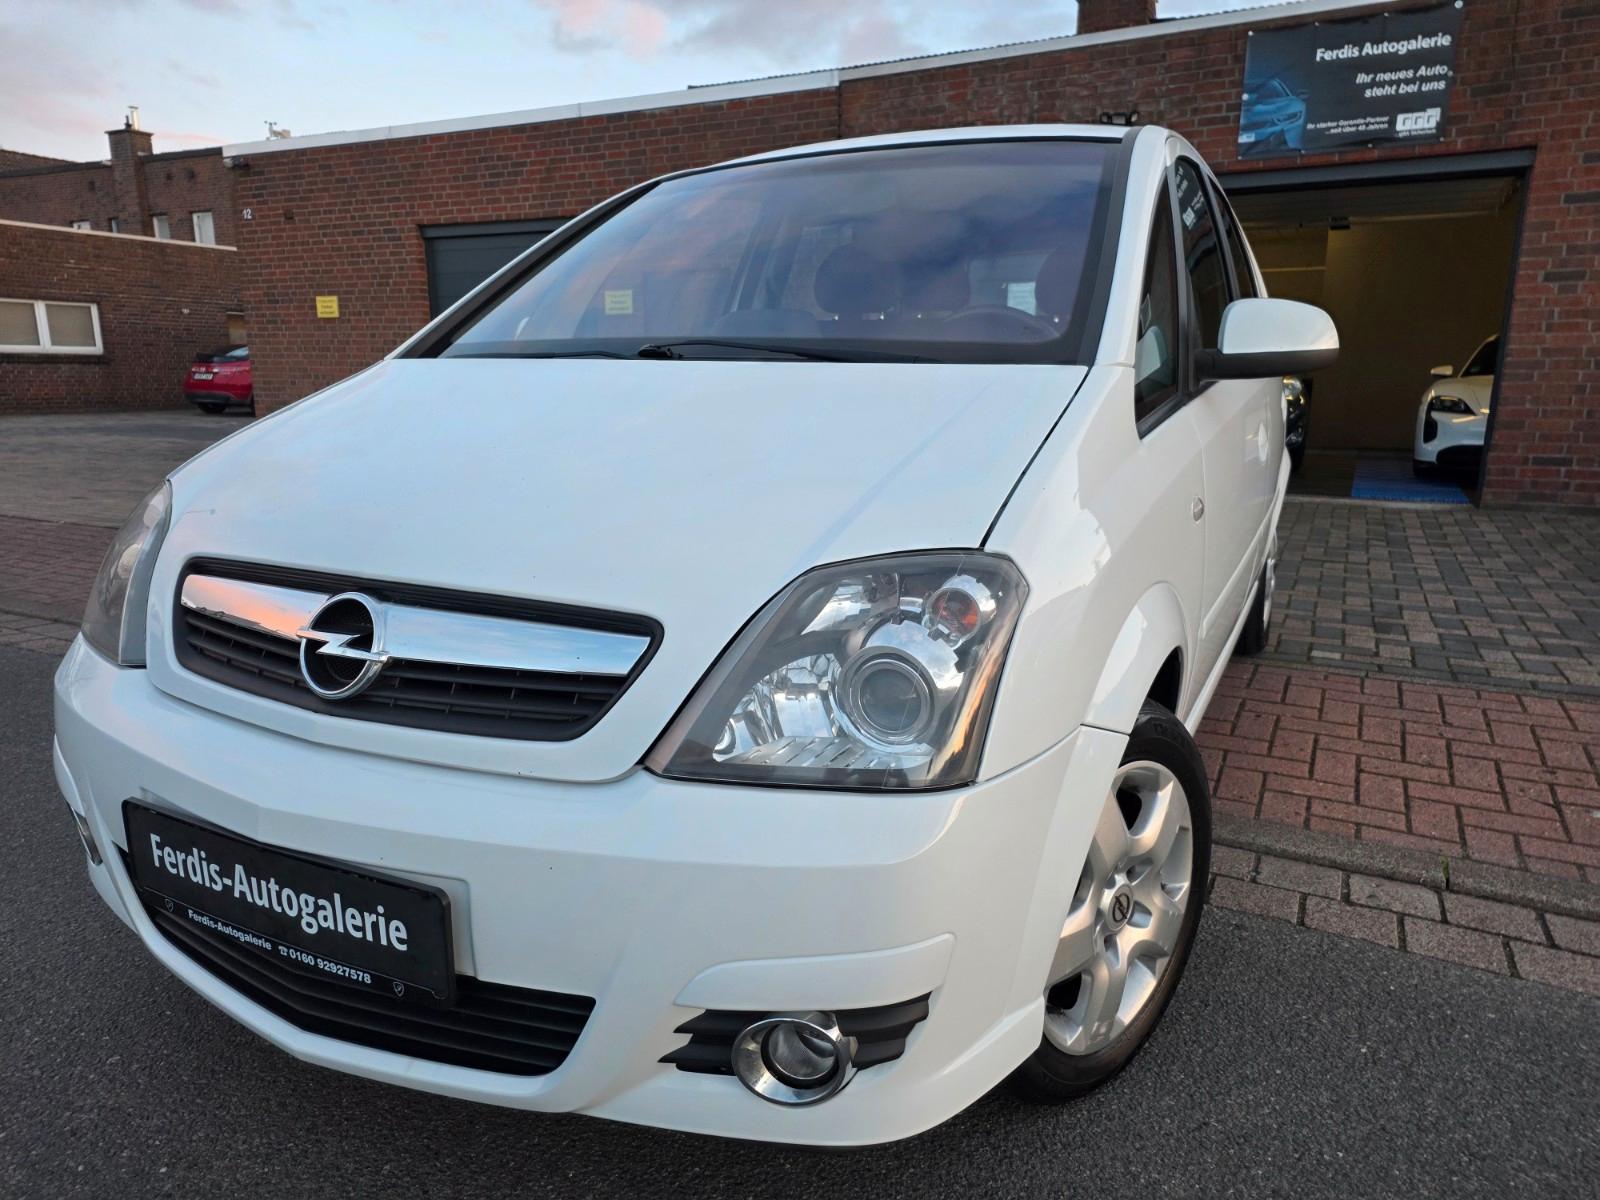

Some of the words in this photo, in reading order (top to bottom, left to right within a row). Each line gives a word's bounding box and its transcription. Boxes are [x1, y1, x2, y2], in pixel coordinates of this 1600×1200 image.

[1316, 44, 1360, 61] Ferdis
[1361, 32, 1452, 55] Autogalerie
[1355, 72, 1373, 84] Ihr
[1375, 68, 1414, 82] neues
[1416, 64, 1448, 77] Auto
[1364, 84, 1397, 98] steht
[1398, 81, 1419, 94] bei
[1421, 80, 1446, 92] uns
[242, 208, 252, 219] 12
[150, 833, 408, 951] Ferdis-Autogalerie
[187, 909, 273, 950] Ferdis-Autogalerie
[289, 950, 315, 966] 0160
[317, 958, 372, 984] 92927578
